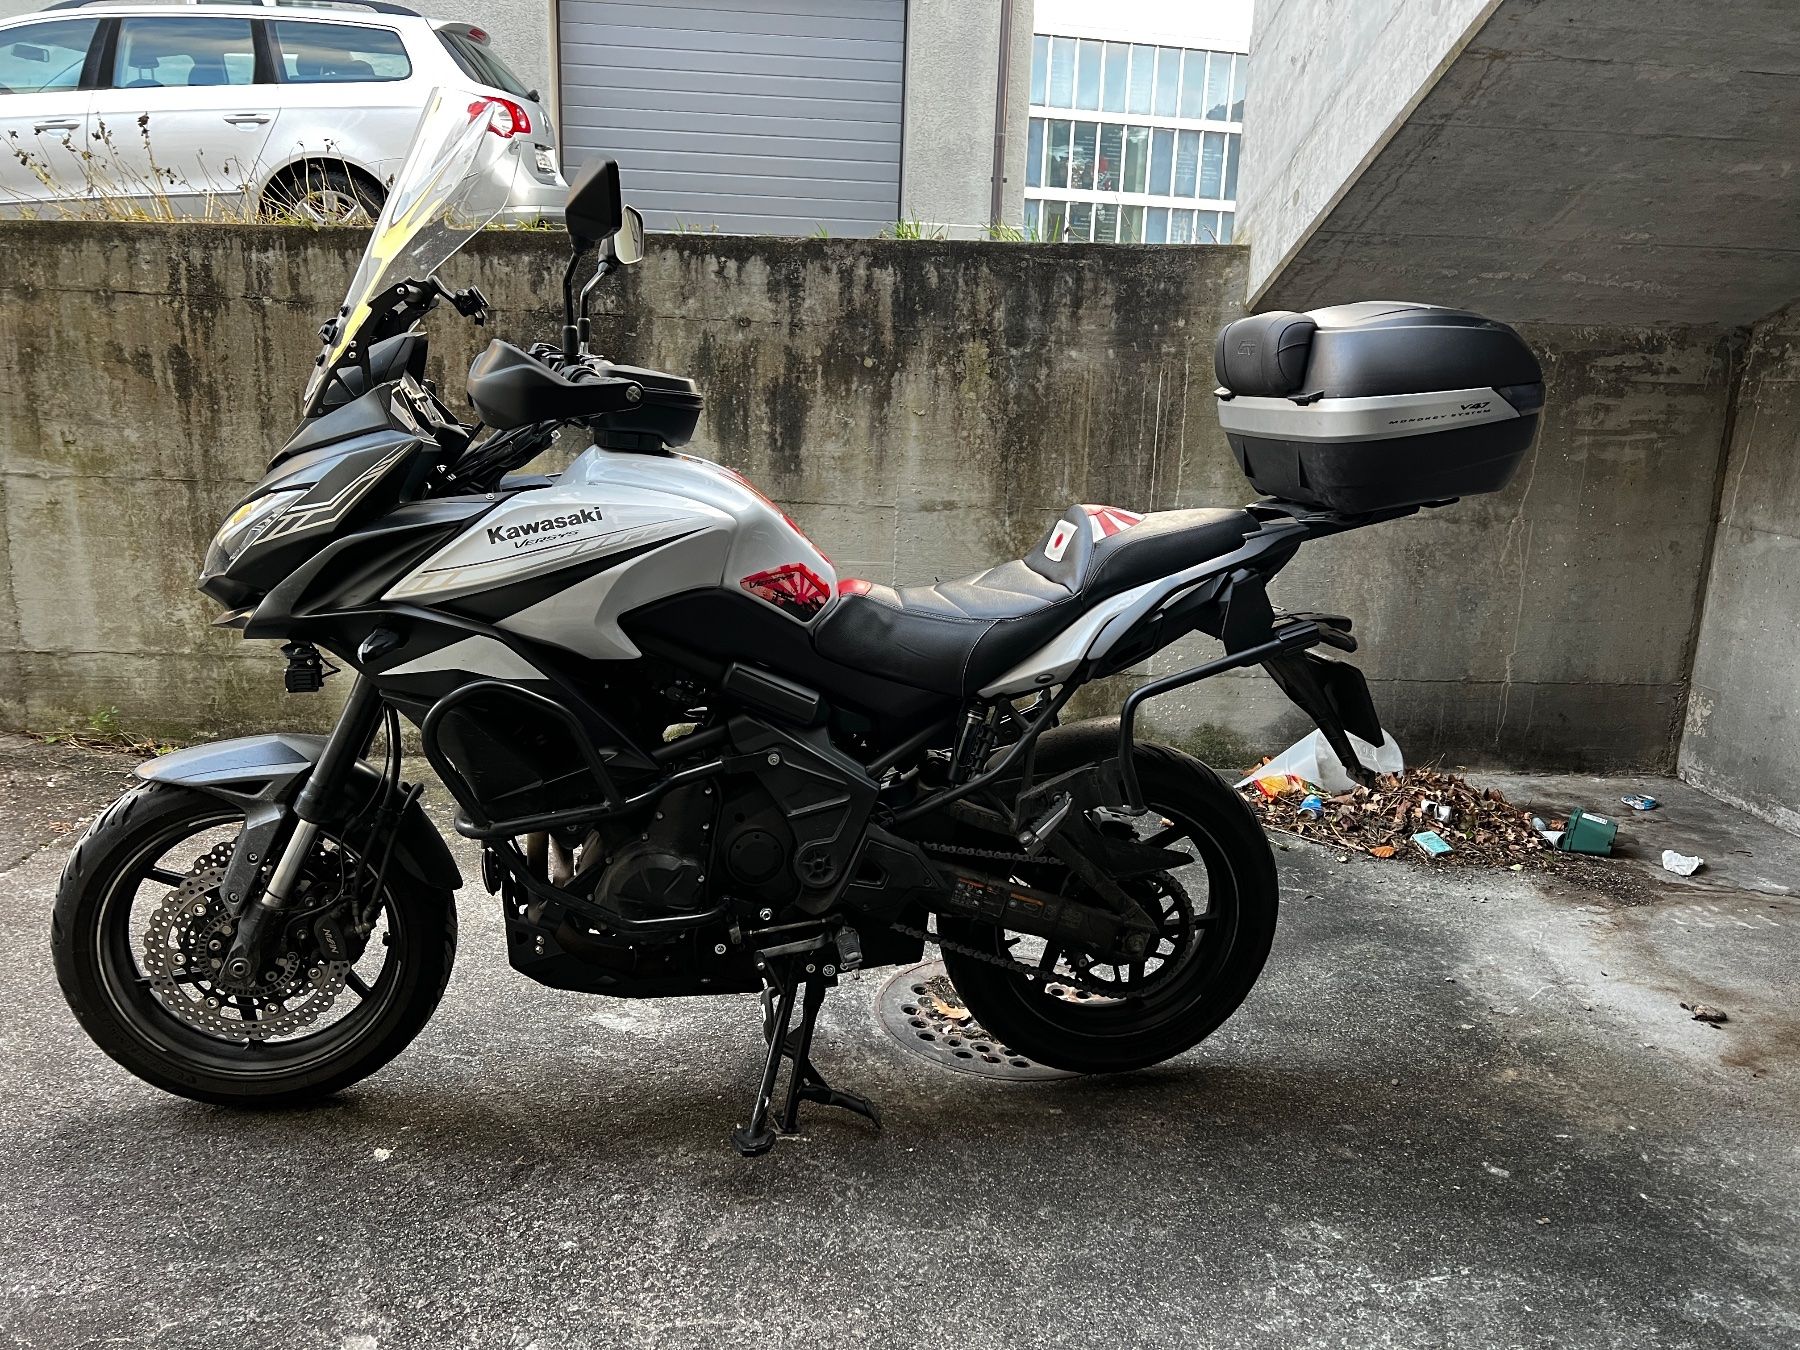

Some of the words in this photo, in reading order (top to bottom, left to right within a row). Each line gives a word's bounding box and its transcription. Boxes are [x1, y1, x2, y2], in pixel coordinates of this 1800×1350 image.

[1460, 402, 1490, 410] V47
[1389, 415, 1447, 424] MONOKEY
[1451, 409, 1490, 417] SYSTEM
[487, 507, 602, 544] Kawasaki
